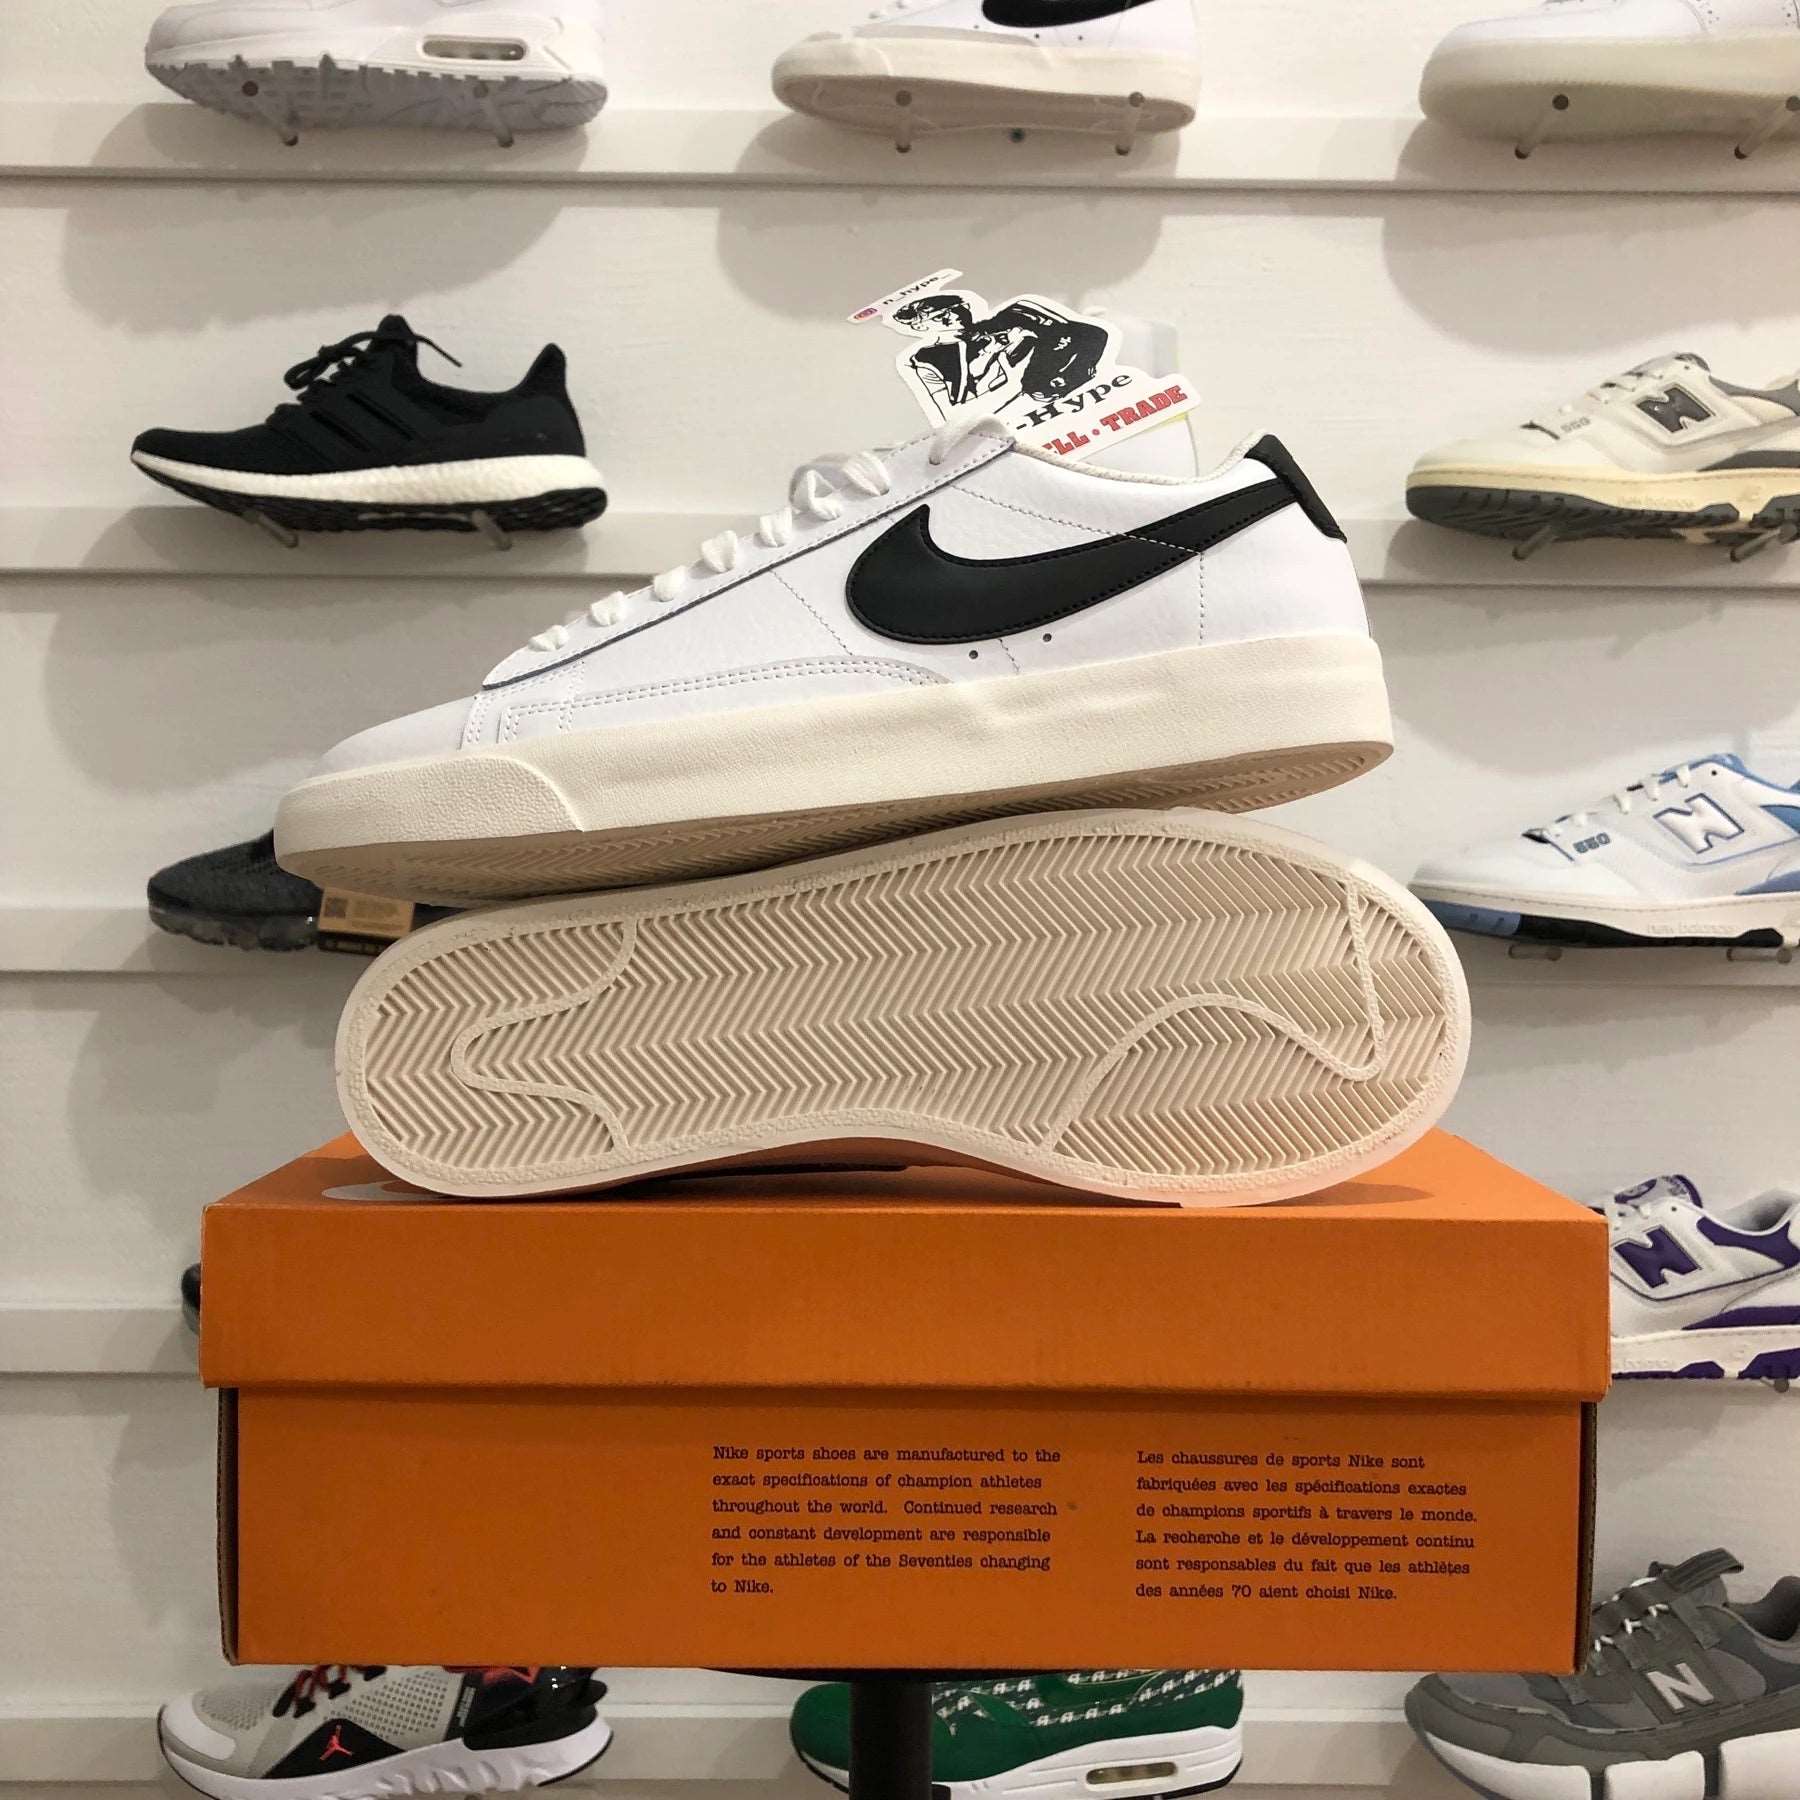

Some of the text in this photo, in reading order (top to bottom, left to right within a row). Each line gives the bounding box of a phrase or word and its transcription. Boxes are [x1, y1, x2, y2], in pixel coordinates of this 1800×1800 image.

[1099, 384, 1188, 432] TRADE
[1652, 793, 1745, 855] N
[1613, 1224, 1703, 1289] N
[712, 1445, 1061, 1463] Nike sports shoes are manufactured to the
[1137, 1450, 1426, 1469] Les chaussures de sports Nike sont
[712, 1472, 1042, 1490] exact specifications of champion athletes
[1136, 1476, 1467, 1496] fabriquées avec les spécifications exactes
[711, 1498, 1058, 1516] throughout the world. Continued research
[1136, 1503, 1478, 1522] de champions sportifs à travers le monde.
[711, 1525, 1051, 1545] and constant development are responsible
[1135, 1529, 1475, 1549] La recherche et le développement continu
[711, 1551, 1051, 1572] for the athletes of the Seventies changing
[1135, 1557, 1471, 1577] sont responsables du fait que les athlètes
[710, 1579, 774, 1594] to Nike.
[1135, 1583, 1398, 1601] des années 70 aient choisi Nike.
[1647, 1662, 1715, 1715] N
